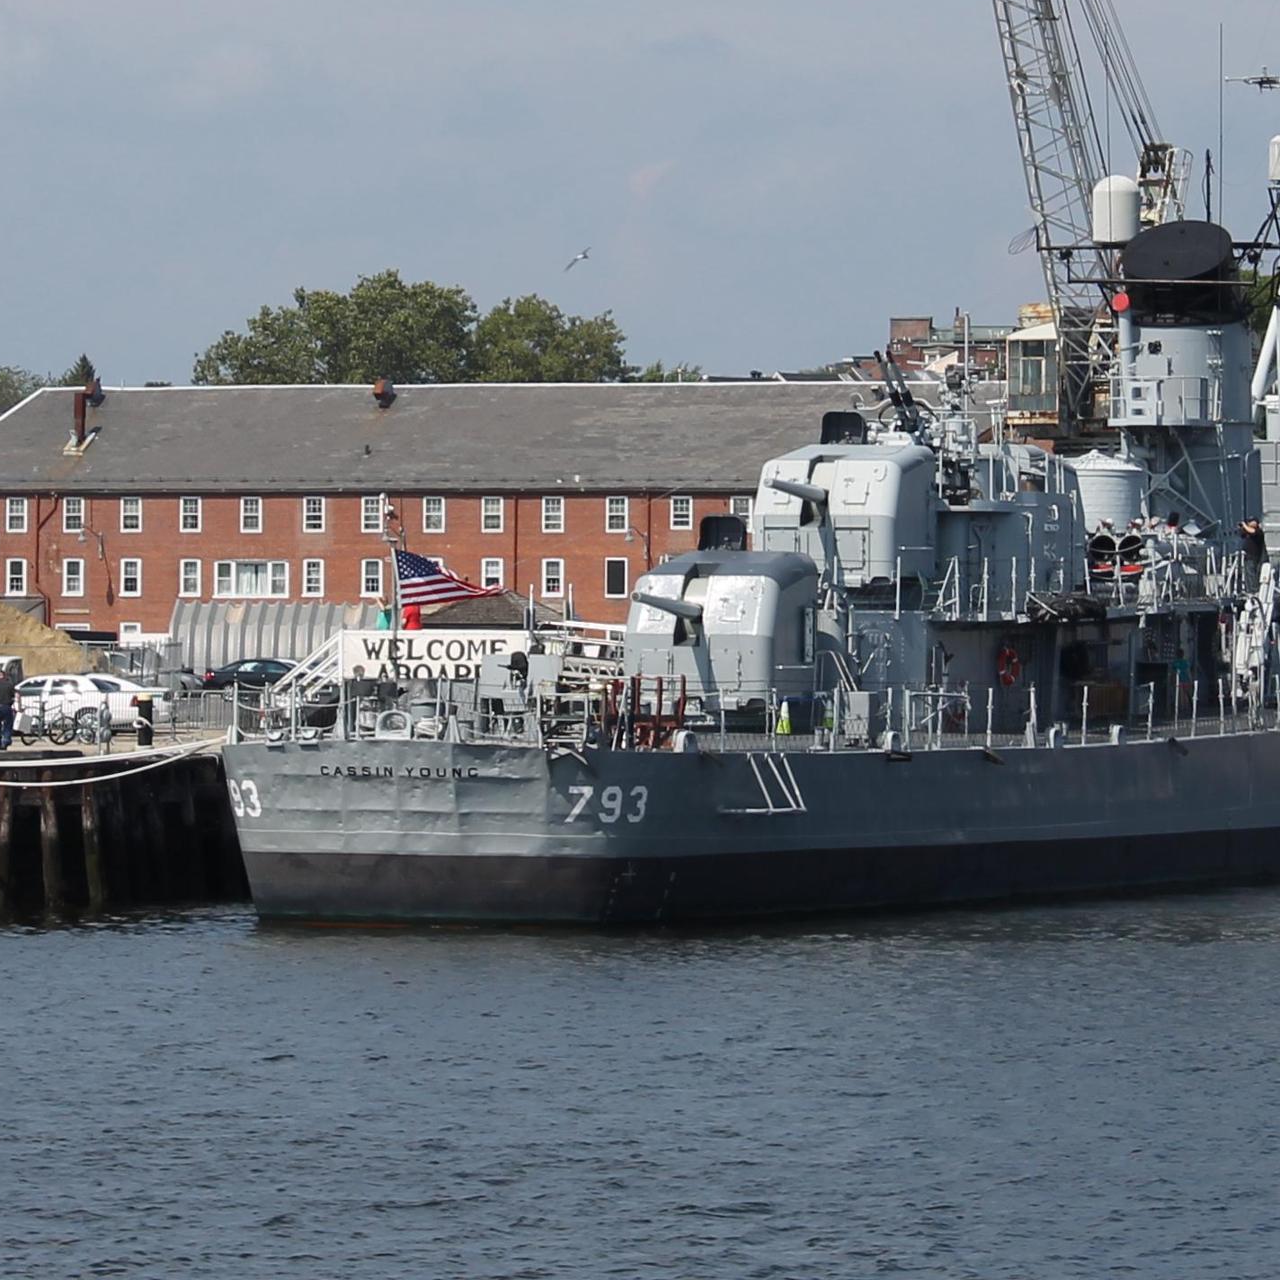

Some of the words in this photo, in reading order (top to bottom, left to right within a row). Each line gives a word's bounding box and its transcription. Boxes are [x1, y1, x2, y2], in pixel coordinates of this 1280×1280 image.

[362, 638, 508, 661] WELCOME
[377, 663, 482, 680] ABOAR
[320, 765, 393, 778] CASSIN
[226, 779, 262, 817] 93
[564, 785, 648, 823] 793
